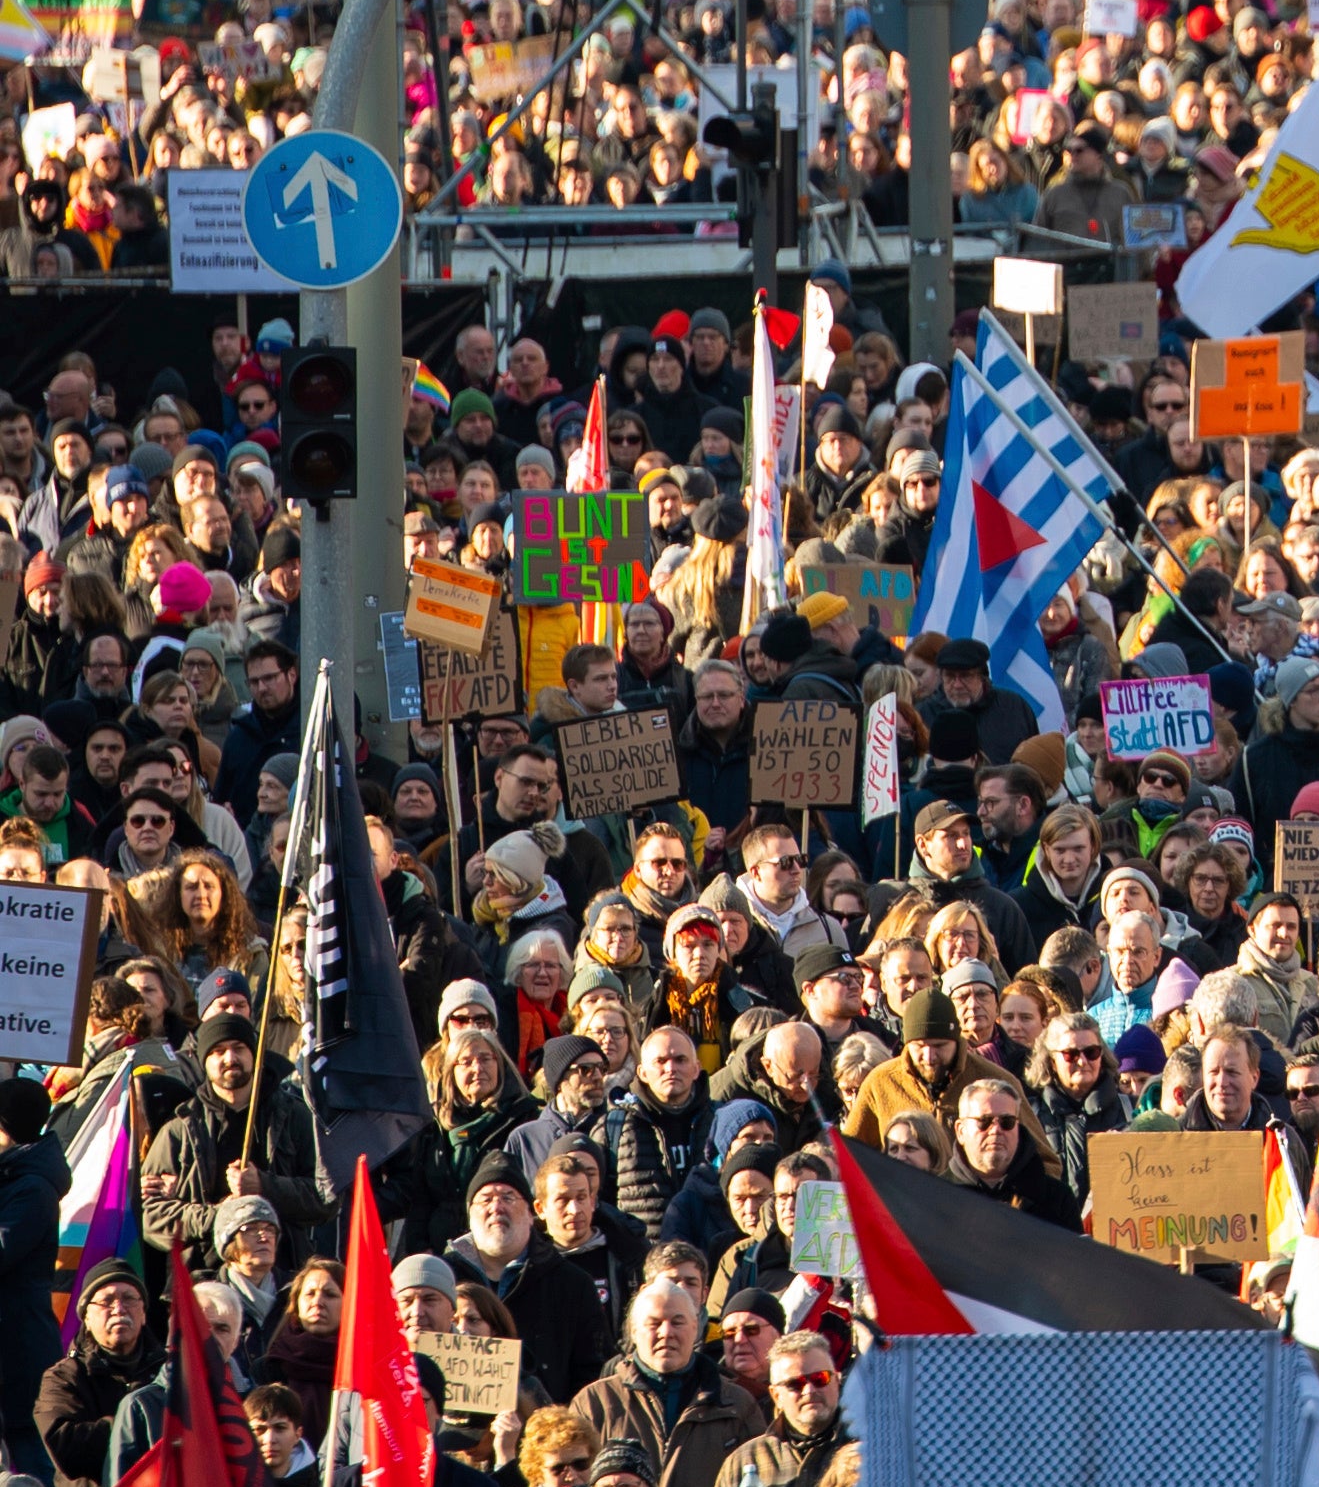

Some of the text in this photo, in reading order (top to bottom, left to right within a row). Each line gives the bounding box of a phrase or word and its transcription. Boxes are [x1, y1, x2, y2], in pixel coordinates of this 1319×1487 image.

[524, 492, 645, 542] BUNT
[560, 535, 609, 564] IST
[522, 547, 650, 604] GESUND
[468, 673, 510, 710] AFD
[778, 701, 838, 725] AFD
[1162, 709, 1216, 748] AFD
[561, 715, 644, 749] LIEBER
[759, 725, 853, 751] WÄHLEN
[566, 738, 677, 779] SOLIDARISCH
[757, 749, 842, 773] IST SO
[569, 767, 670, 801] ALS SOLIDE
[771, 770, 842, 803] 1933
[1282, 828, 1313, 847] NIE
[1, 952, 66, 980] keine
[1118, 1146, 1216, 1185] Hass ist
[1108, 1211, 1260, 1250] MEINUNG!
